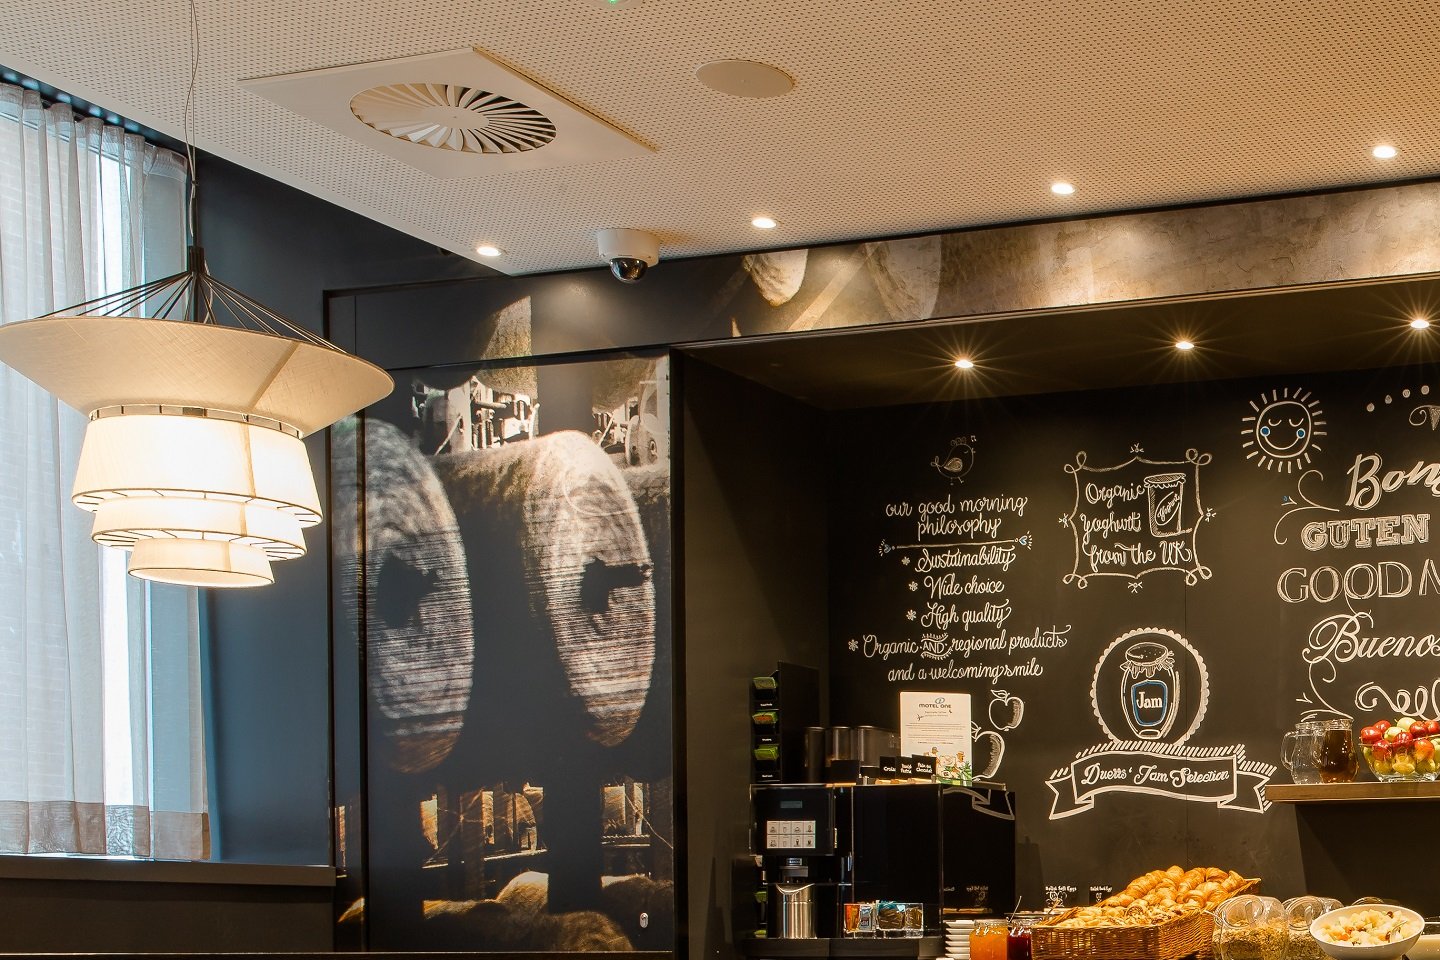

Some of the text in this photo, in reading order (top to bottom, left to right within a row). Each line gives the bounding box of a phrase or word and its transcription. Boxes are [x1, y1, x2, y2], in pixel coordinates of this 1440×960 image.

[886, 494, 1028, 522] our good morning
[1086, 483, 1145, 509] Organic
[917, 513, 1002, 541] philosophy
[1300, 513, 1430, 552] GUTEN
[915, 545, 1016, 573] Sustainability
[1090, 541, 1192, 572] from the UK
[923, 572, 1005, 599] Wide choice
[1276, 561, 1413, 603] GOOD
[921, 599, 1012, 631] High quality
[862, 625, 1072, 660] Organic AND regional products
[888, 657, 1043, 684] and a welcoming smile
[1137, 691, 1162, 709] Jam
[1134, 765, 1168, 785] Jam
[1170, 768, 1230, 788] Selection
